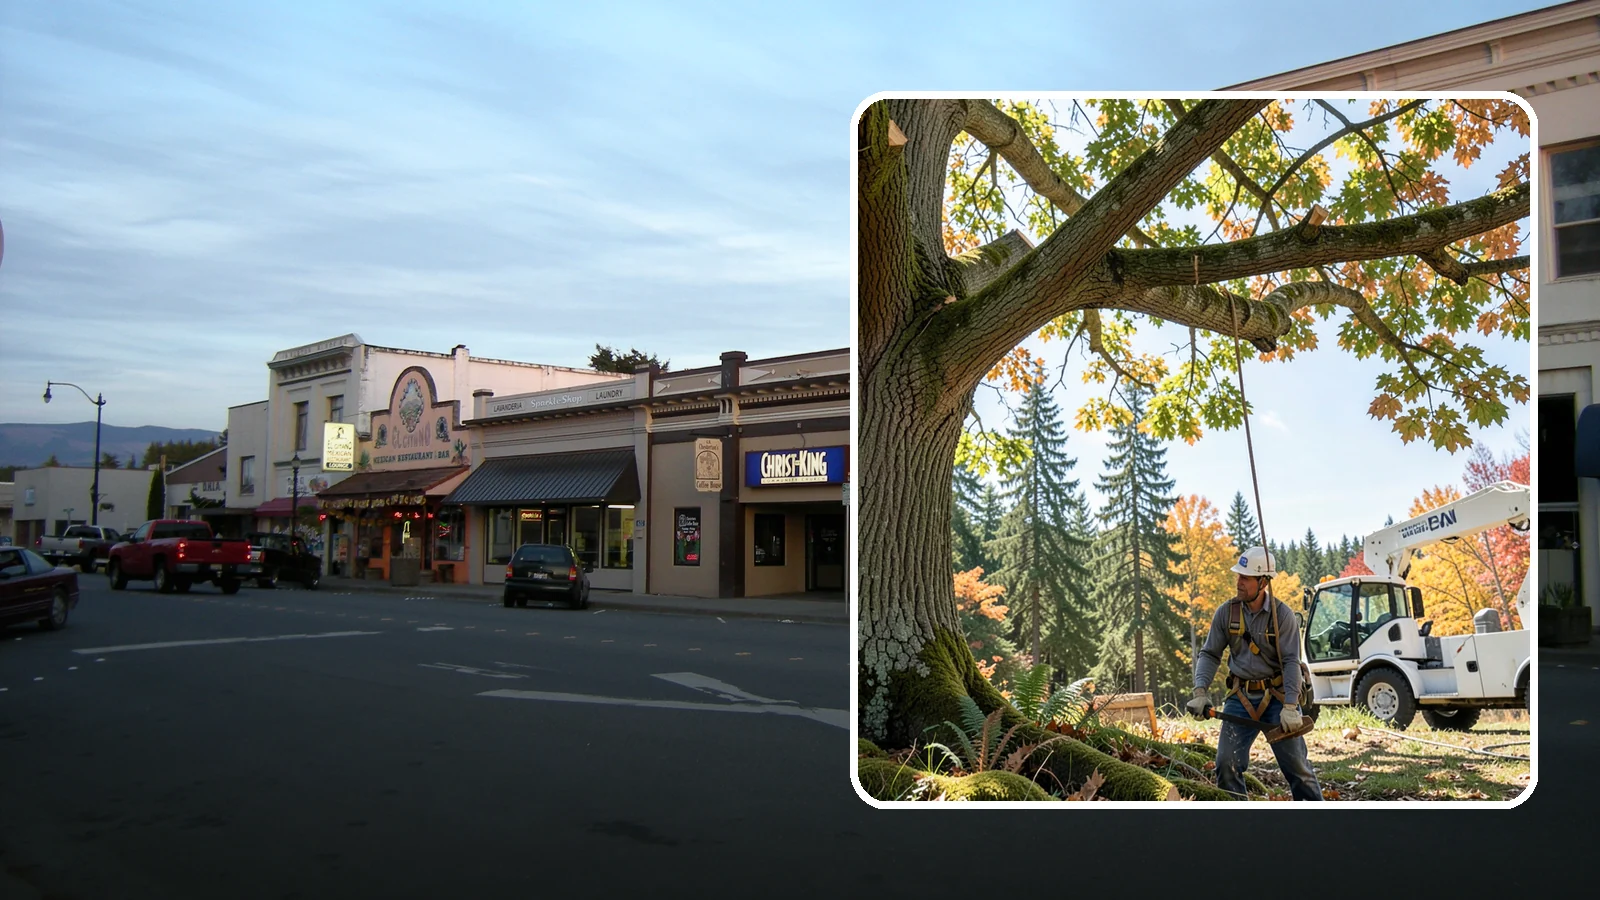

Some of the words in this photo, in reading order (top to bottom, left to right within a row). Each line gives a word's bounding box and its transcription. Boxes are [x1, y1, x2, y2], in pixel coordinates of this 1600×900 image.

[561, 394, 583, 405] Shop
[595, 389, 623, 399] LAUNDRY
[493, 402, 522, 412] LAVANDERIA
[373, 455, 396, 464] MEXICAN
[397, 451, 433, 462] RESTAURANT
[438, 450, 450, 458] BAR
[760, 452, 797, 478] CHRIST
[799, 450, 827, 476] KING
